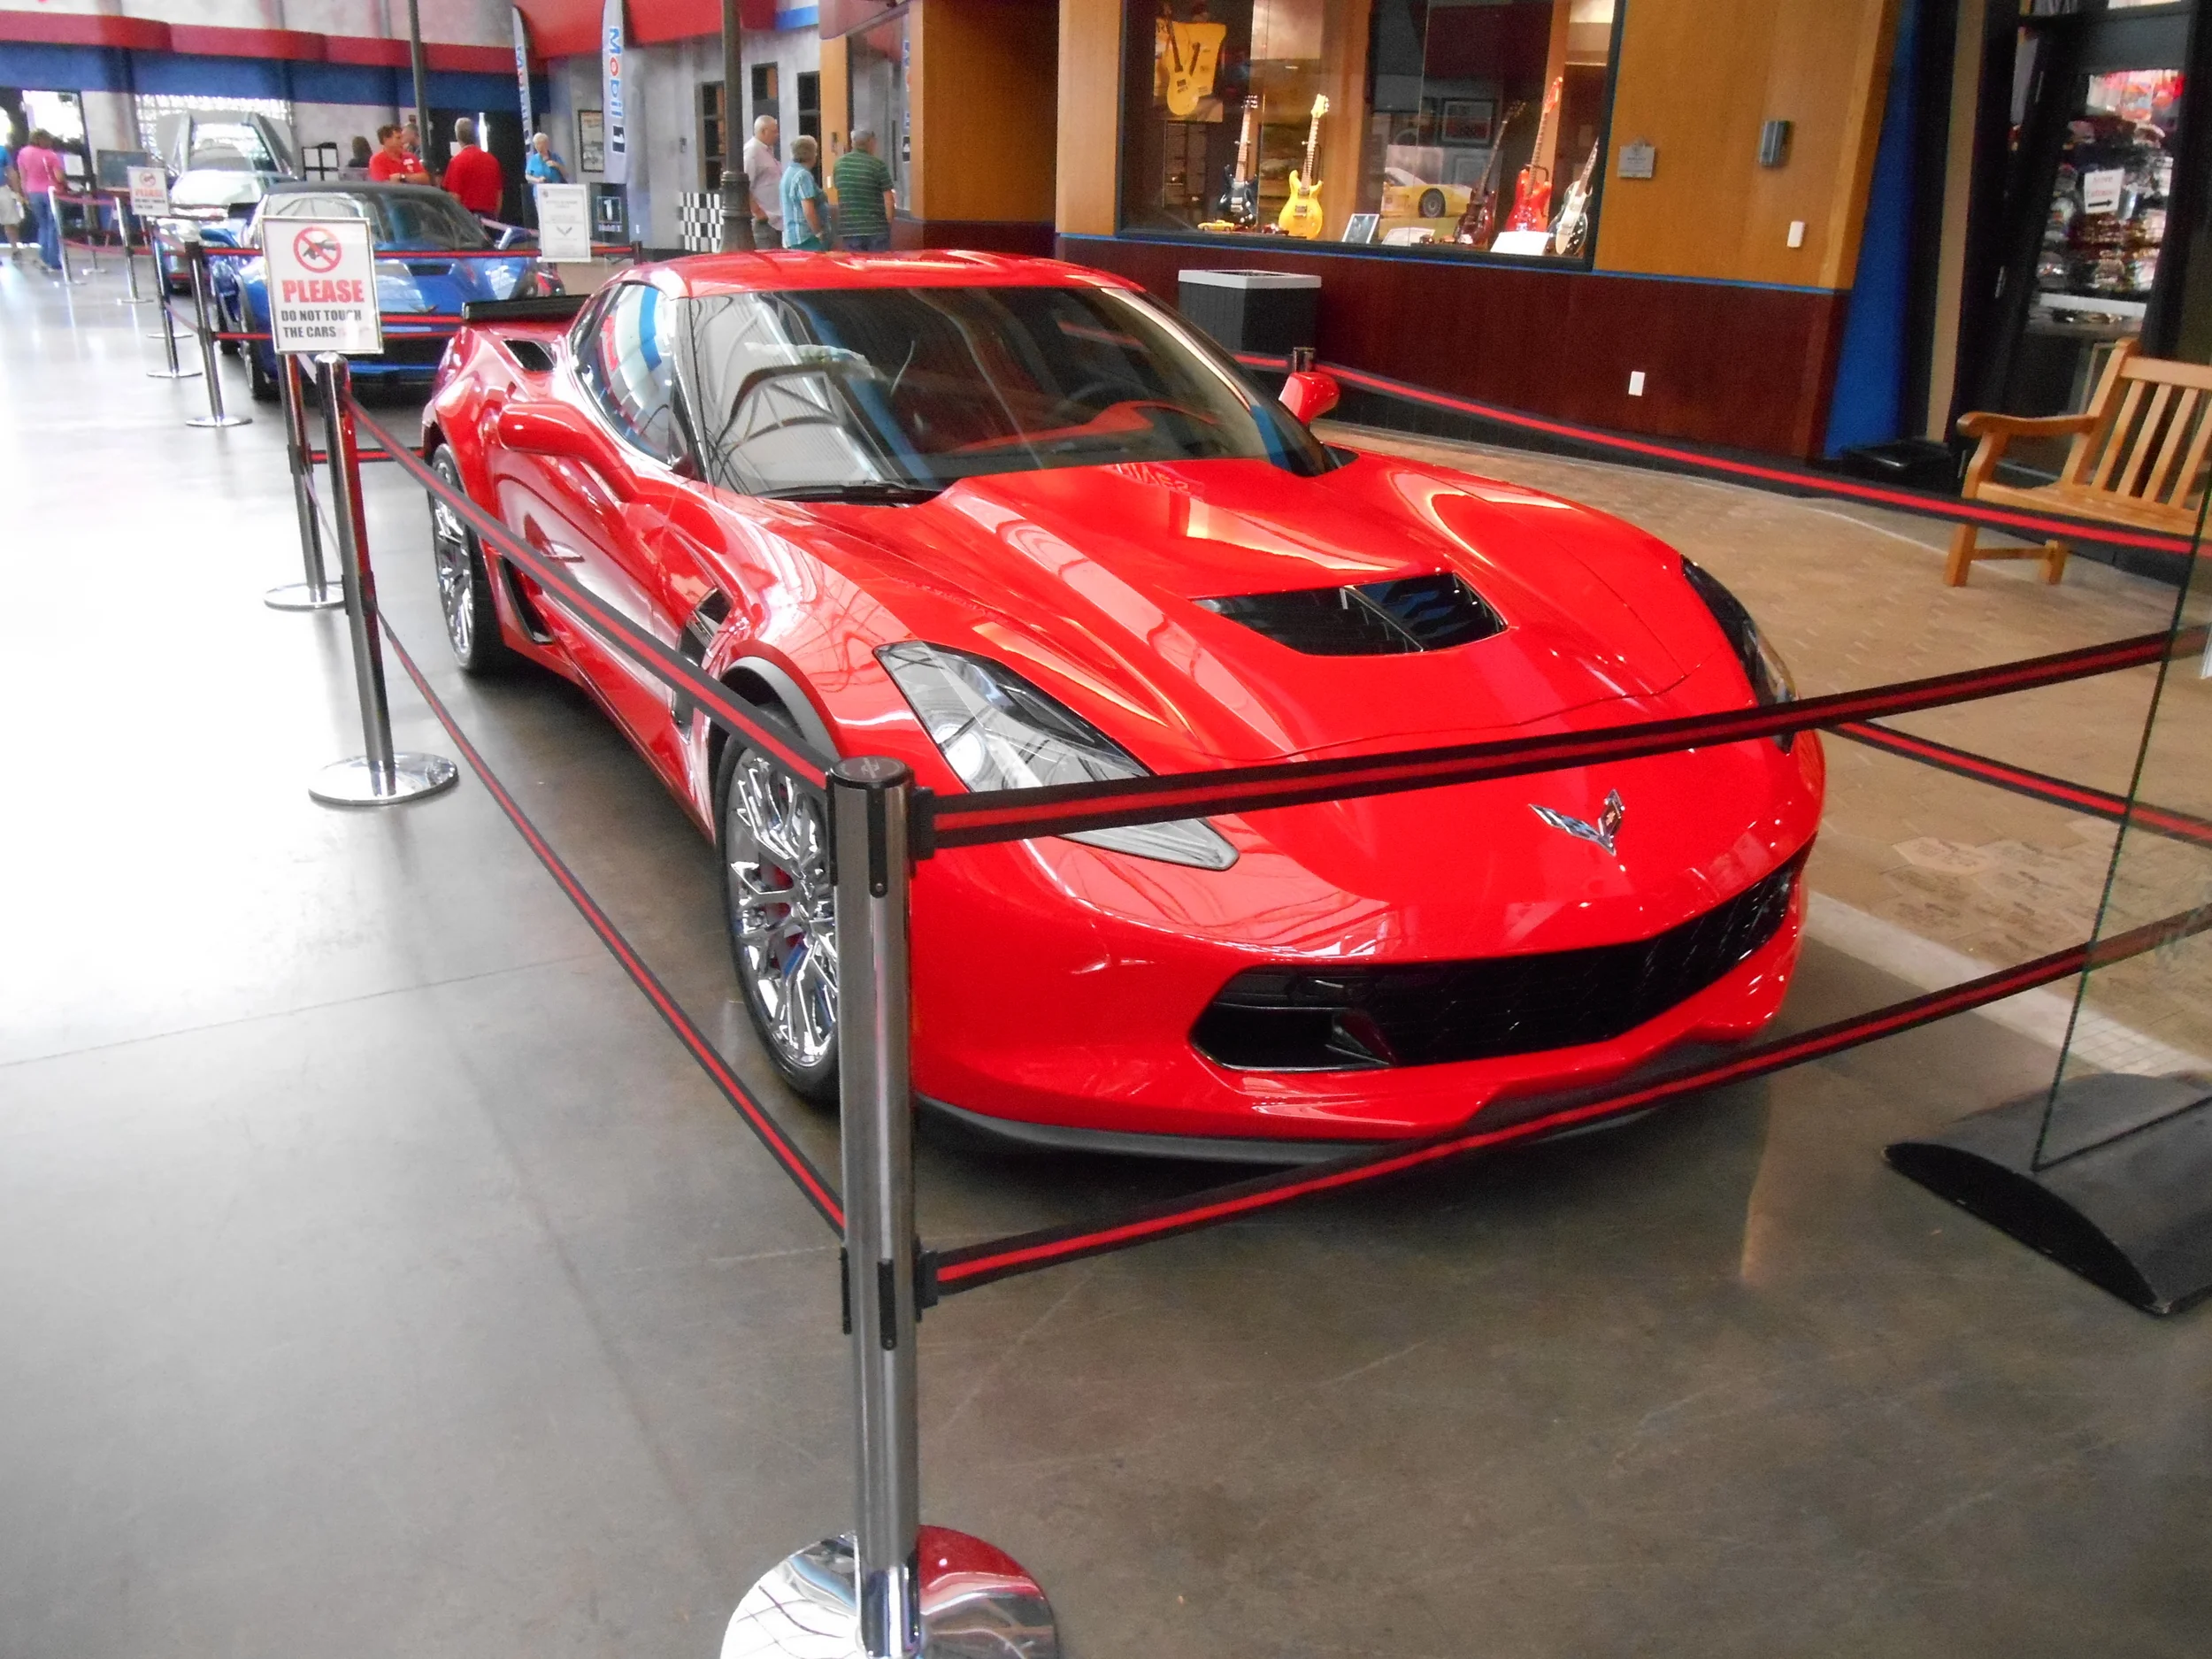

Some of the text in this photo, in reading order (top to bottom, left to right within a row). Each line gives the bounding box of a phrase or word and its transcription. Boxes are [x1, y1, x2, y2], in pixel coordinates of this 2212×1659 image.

[609, 27, 622, 118] Mobil
[281, 280, 365, 303] PLEASE
[280, 310, 296, 321] DO
[299, 310, 320, 321] NOT
[283, 326, 337, 338] THE CARS
